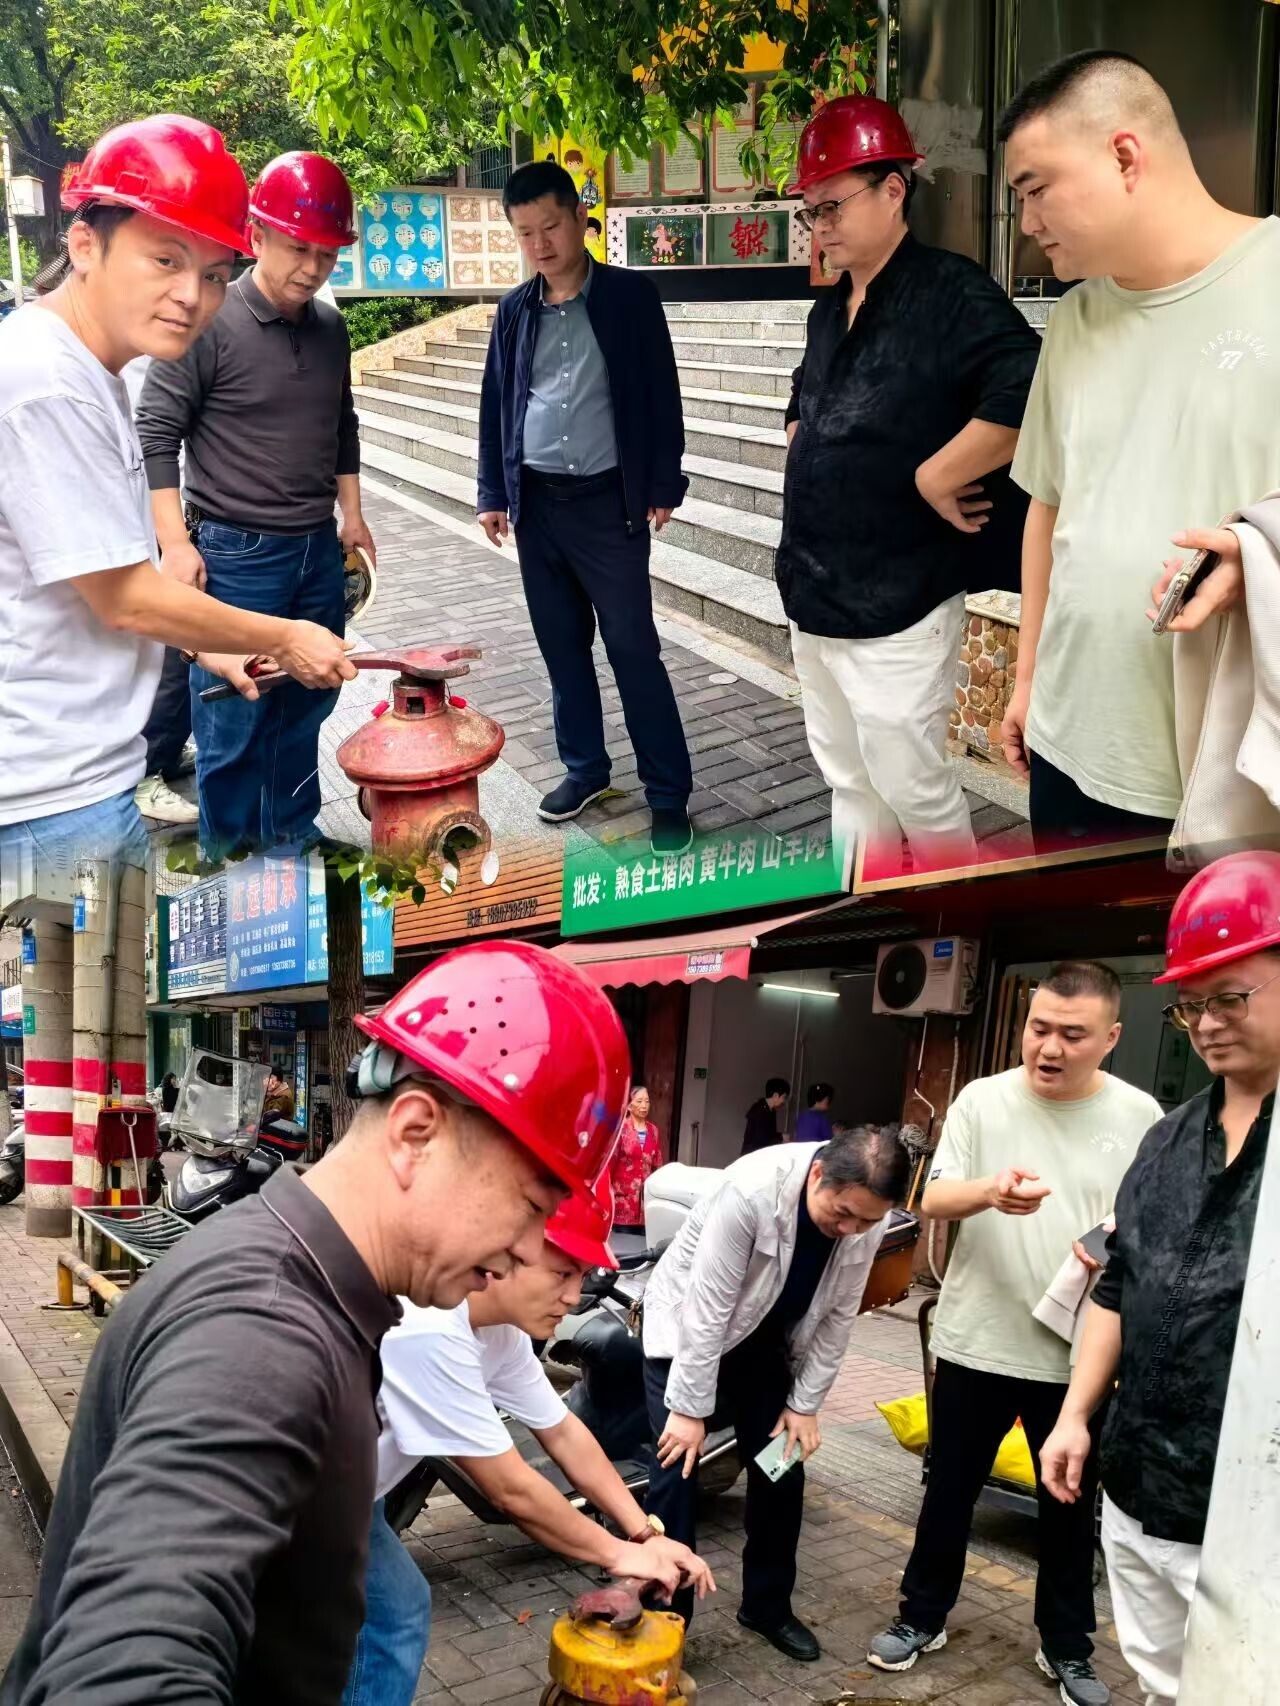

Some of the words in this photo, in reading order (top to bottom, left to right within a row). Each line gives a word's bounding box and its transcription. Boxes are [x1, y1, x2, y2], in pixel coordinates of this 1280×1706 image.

[651, 256, 676, 264] 2026
[699, 838, 757, 884] 黄牛肉
[181, 888, 221, 933] 日丰管
